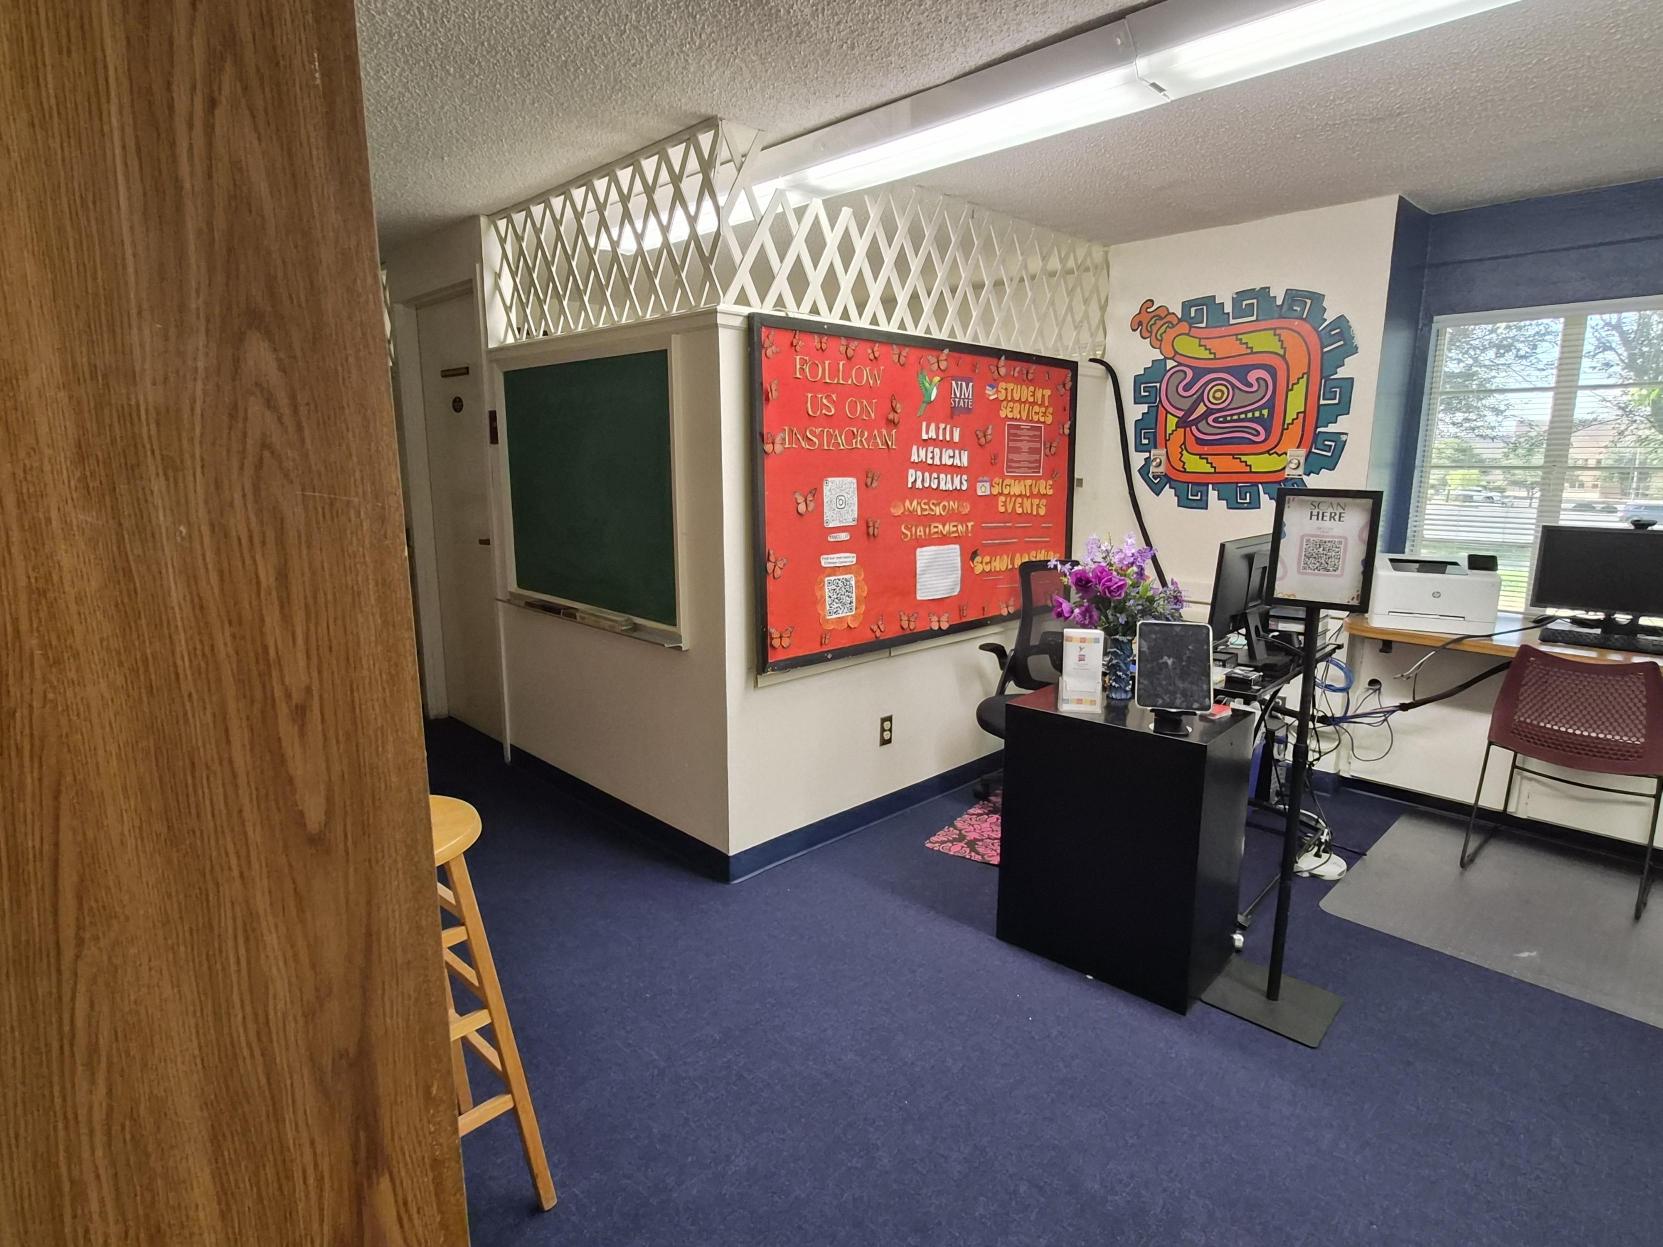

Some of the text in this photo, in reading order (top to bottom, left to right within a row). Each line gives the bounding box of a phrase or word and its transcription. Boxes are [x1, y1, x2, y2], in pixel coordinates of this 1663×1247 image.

[794, 355, 885, 386] FOLLOW
[951, 380, 974, 399] NM
[997, 382, 1052, 406] STUDENT
[806, 393, 878, 420] US ON
[950, 399, 973, 409] STATE
[999, 401, 1054, 425] SERVICES
[783, 426, 897, 450] INSTAGRAM
[921, 421, 960, 442] LATIN
[910, 445, 968, 468] AMERICAN
[907, 469, 968, 491] PROGRAMS
[991, 478, 1054, 496] SIGNATURE
[998, 496, 1047, 515] EVENTS
[1310, 500, 1347, 511] SCAN
[1309, 511, 1346, 522] HERE
